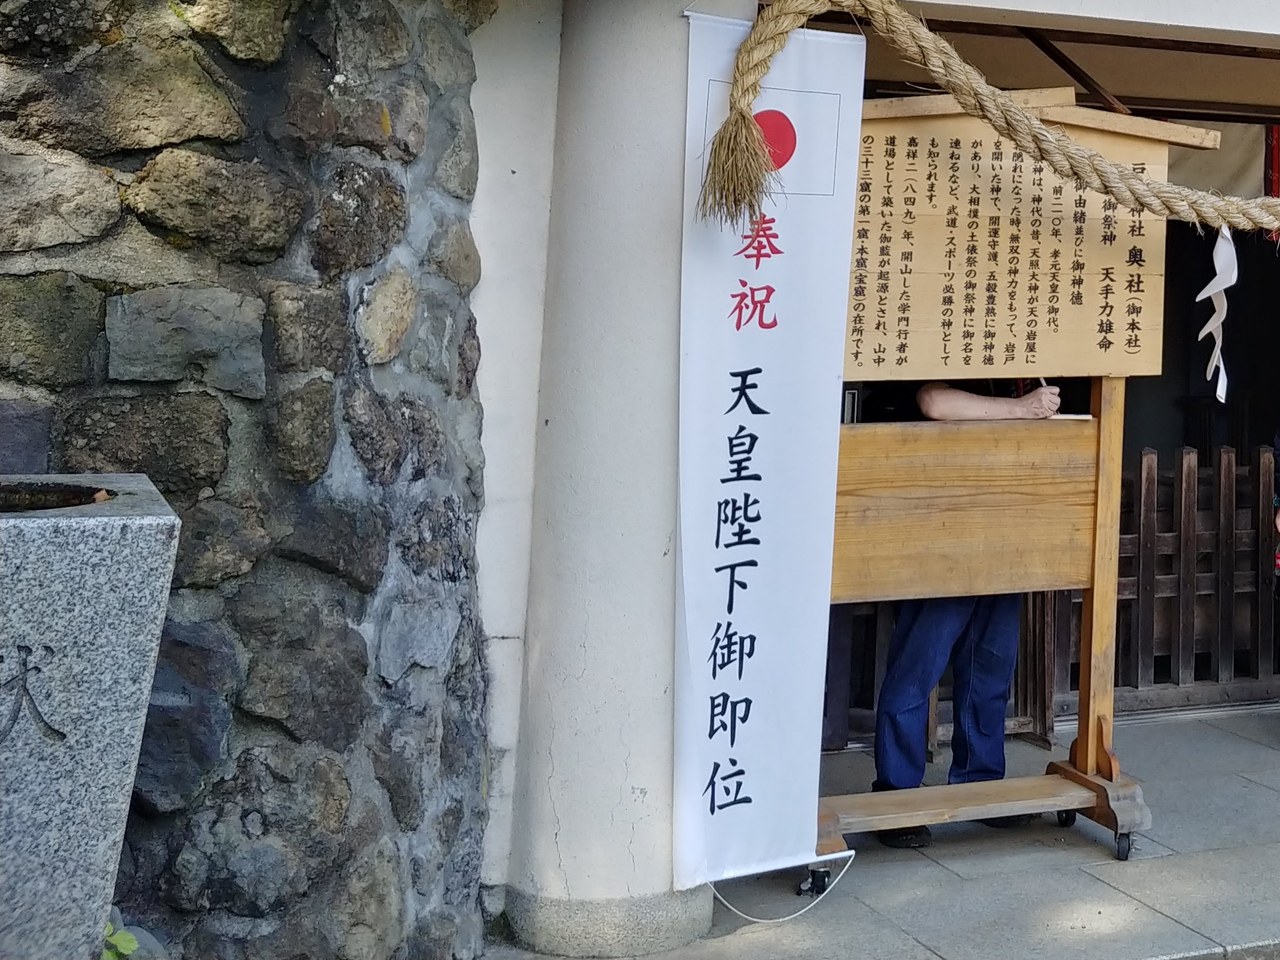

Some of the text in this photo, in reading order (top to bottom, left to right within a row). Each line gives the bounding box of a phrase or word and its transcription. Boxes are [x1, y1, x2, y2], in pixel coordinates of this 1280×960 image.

[925, 136, 940, 210] も知られます。
[1096, 266, 1117, 353] 天手力雄命
[702, 213, 785, 816] 奉祝 天皇陛下御即位
